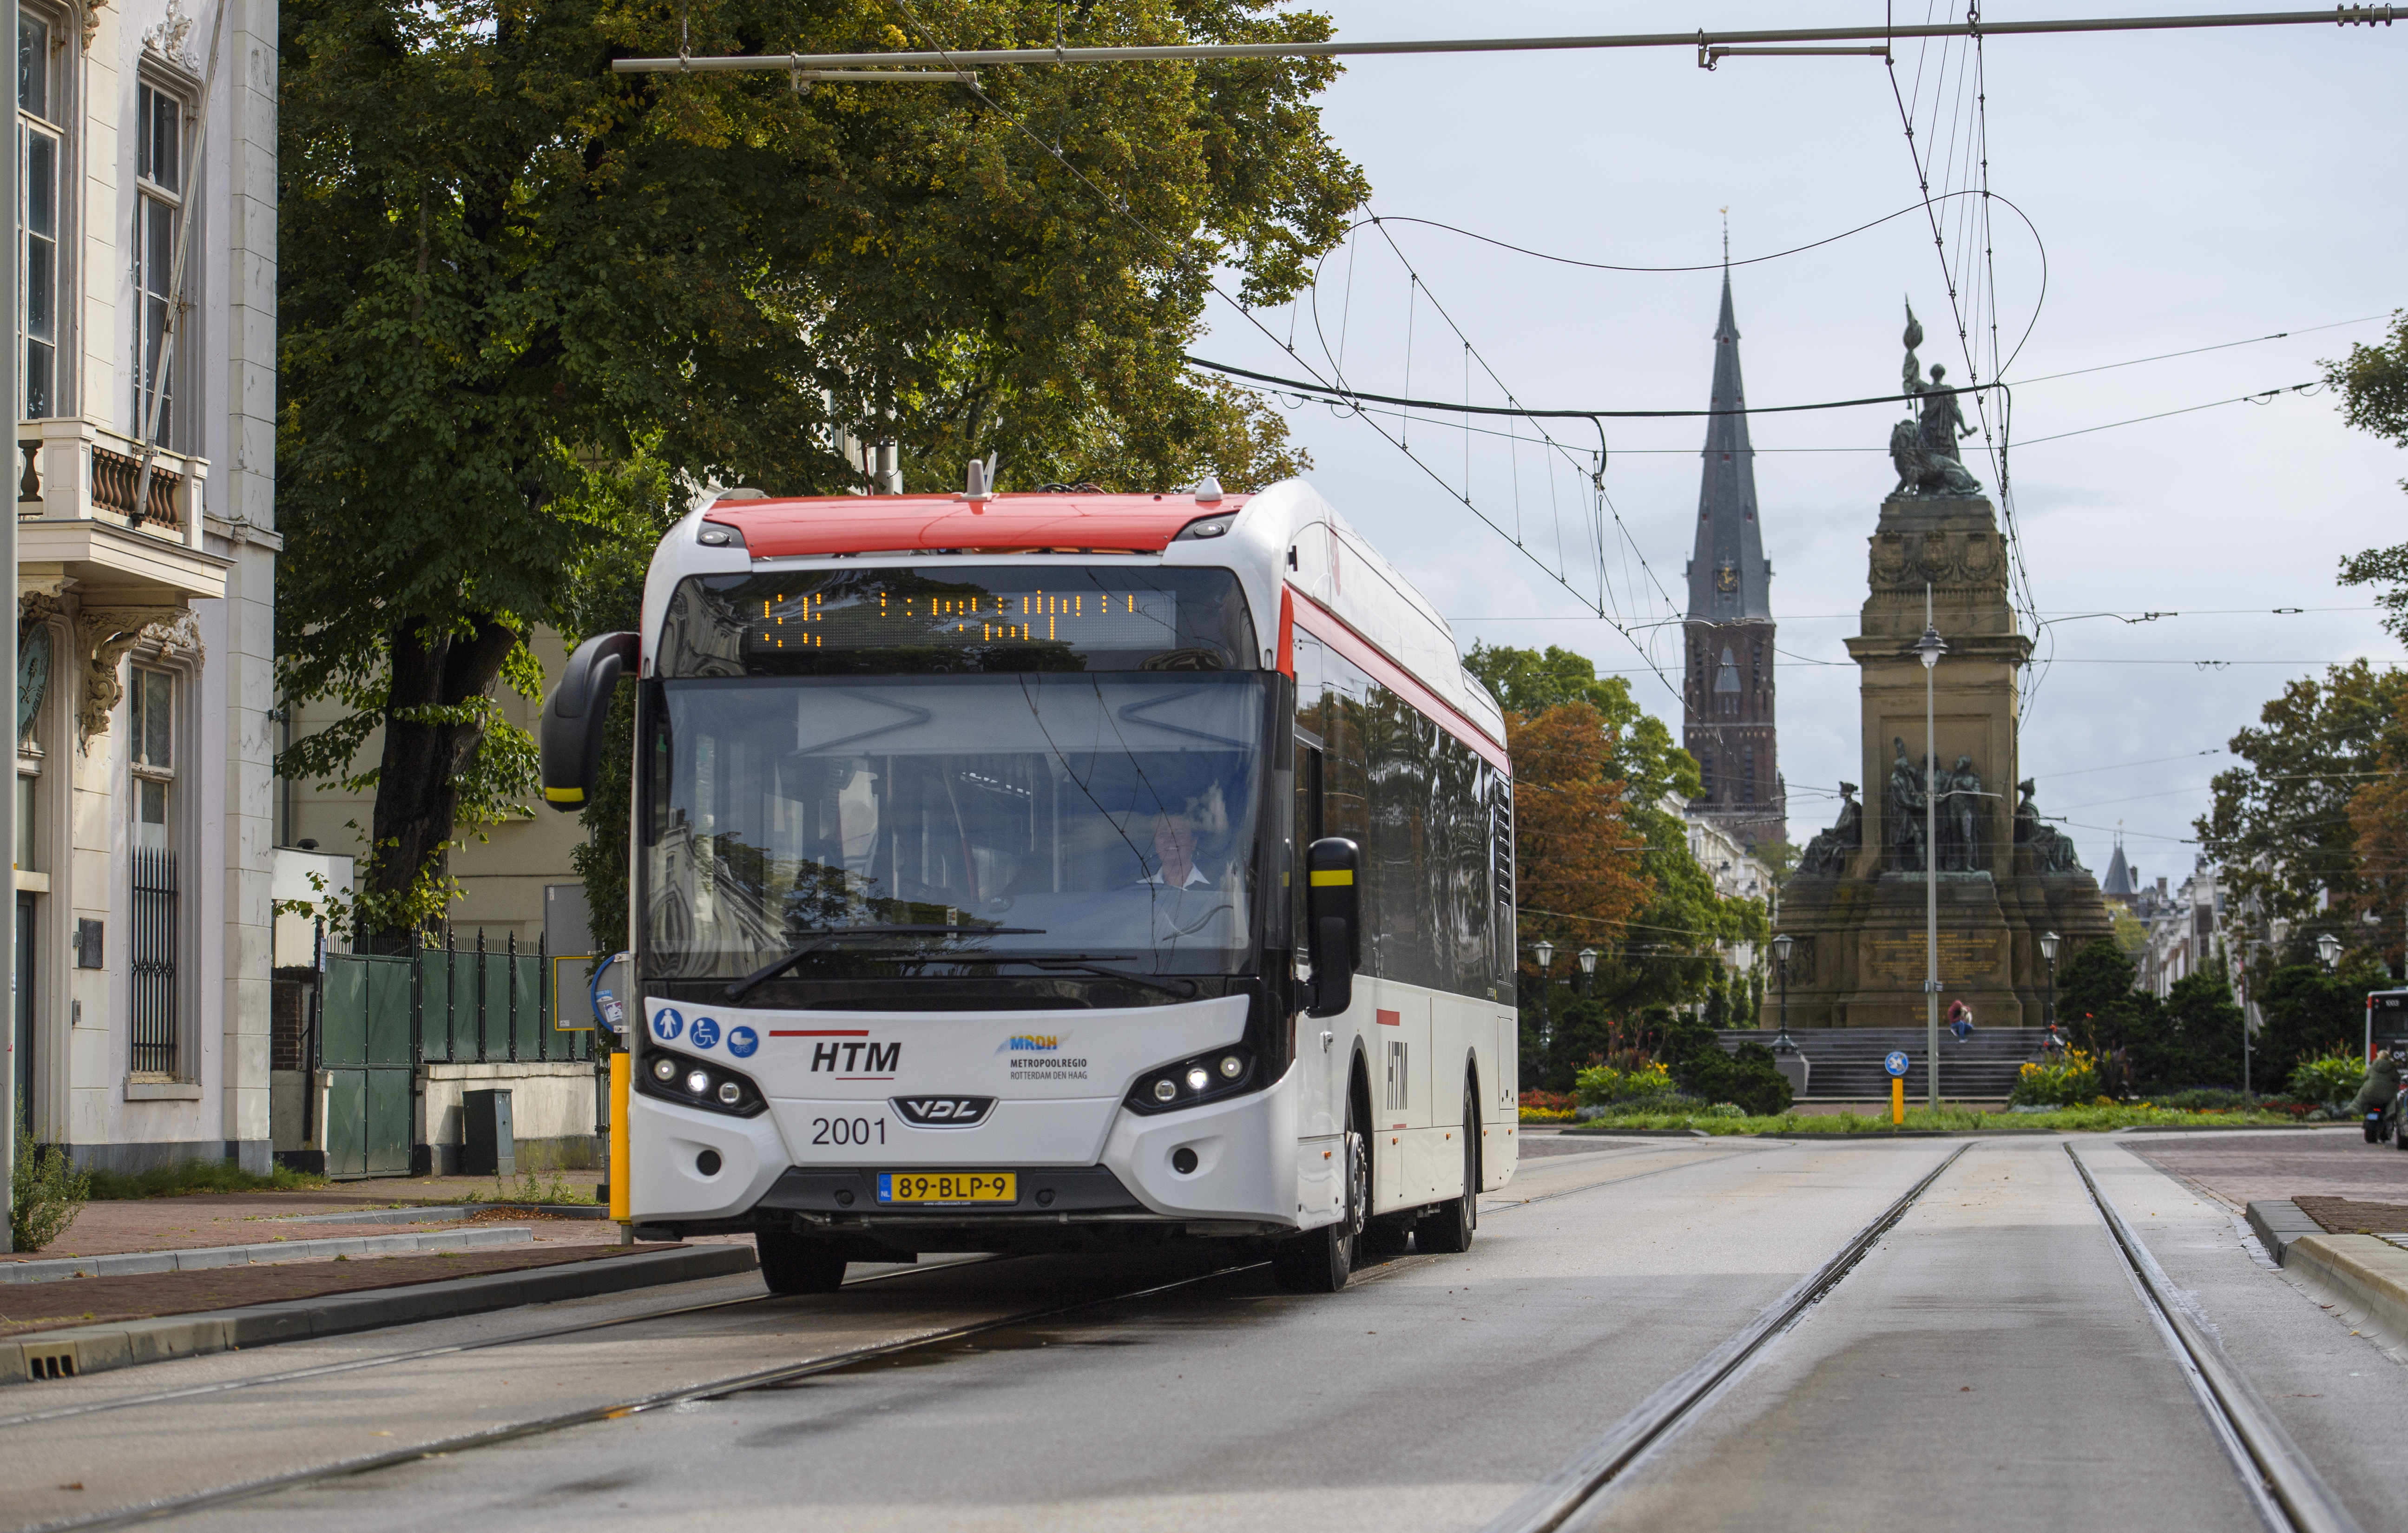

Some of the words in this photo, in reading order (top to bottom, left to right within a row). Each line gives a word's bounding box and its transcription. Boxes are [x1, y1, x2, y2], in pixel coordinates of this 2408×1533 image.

[1009, 1035, 1057, 1050] MRDH
[810, 1042, 901, 1072] HTM
[1010, 1059, 1087, 1068] METROPOOLREGIO
[1010, 1072, 1051, 1080] ROTTERDAM
[1068, 1071, 1087, 1079] HAAG
[1387, 1040, 1408, 1110] HTM
[907, 1101, 977, 1118] VDL
[812, 1118, 885, 1145] 2001
[899, 1177, 1006, 1198] 89-BLP-9
